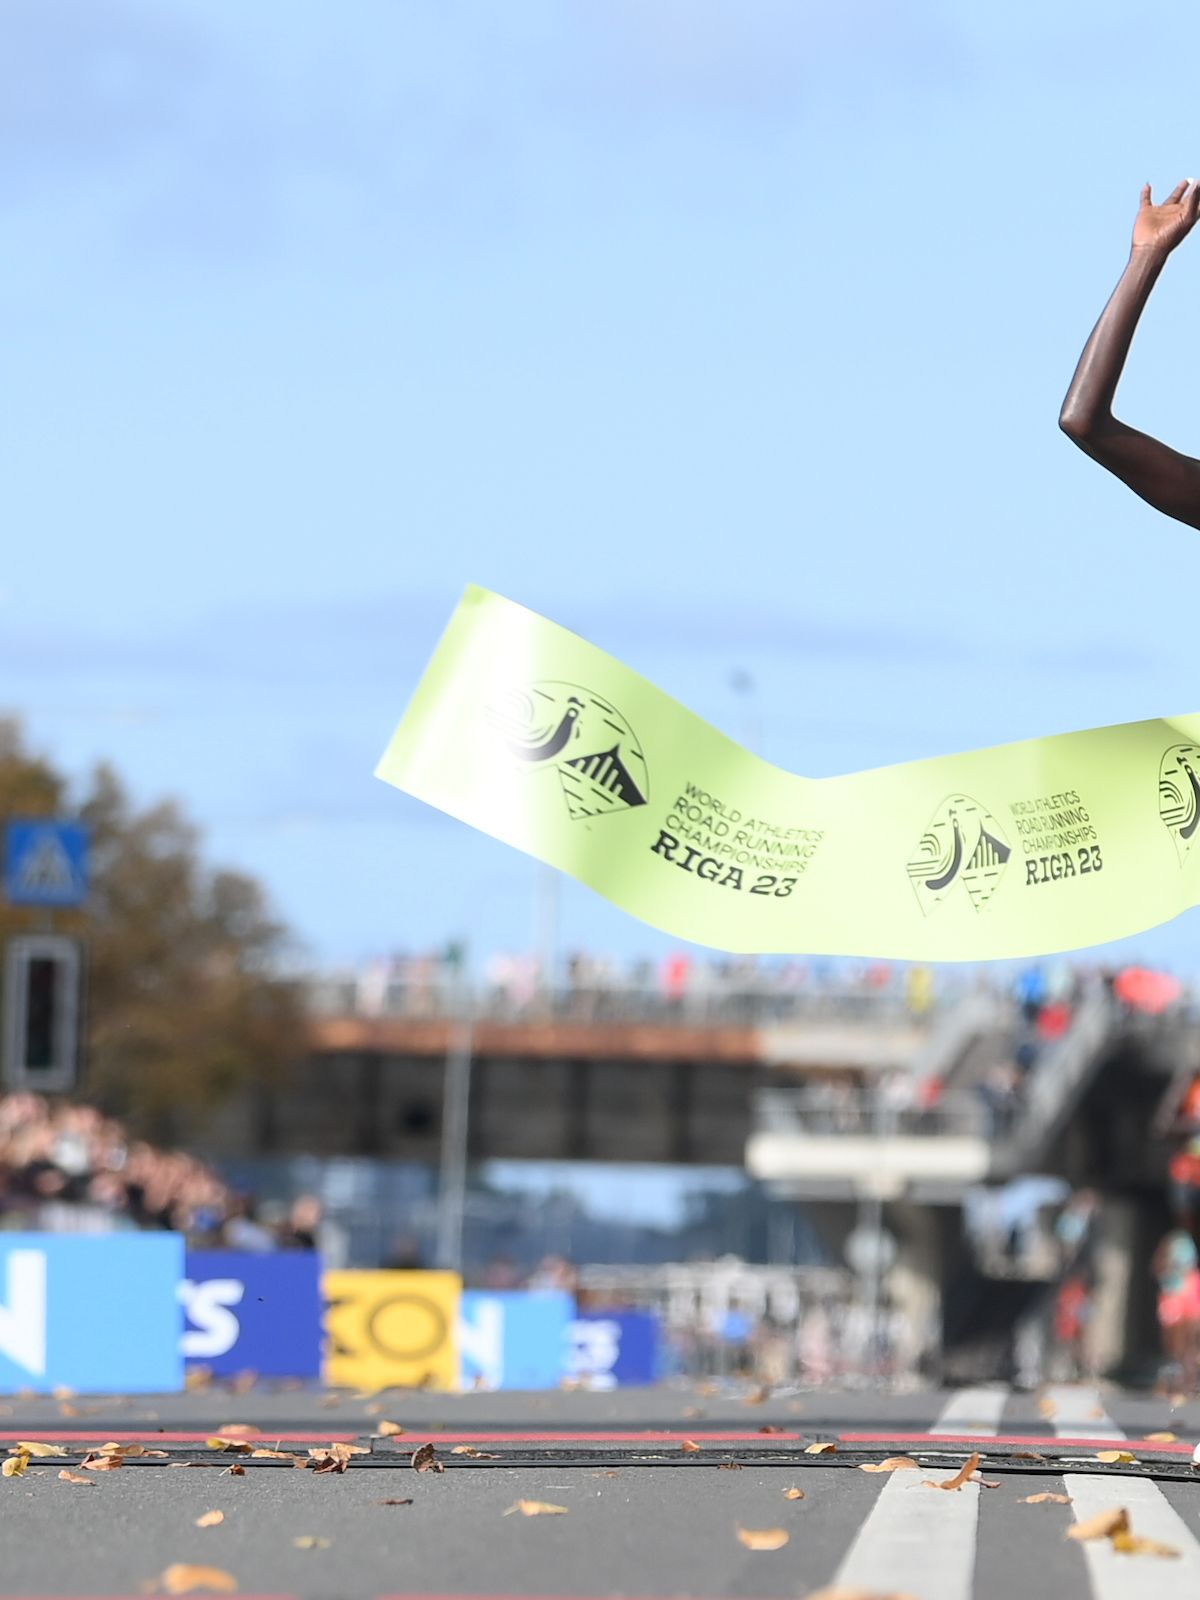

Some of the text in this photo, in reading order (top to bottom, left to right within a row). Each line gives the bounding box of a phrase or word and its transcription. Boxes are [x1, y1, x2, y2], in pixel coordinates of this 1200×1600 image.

[673, 796, 817, 858] ROAD RUNNING
[685, 781, 825, 842] WORLD ATHLETICS
[1022, 825, 1098, 854] CHAMPIONSHIPS
[1040, 806, 1090, 832] RUNNING
[650, 829, 798, 897] RIGA 23
[665, 813, 808, 874] CHAMPIONSHIPS
[1025, 845, 1103, 886] RIGA 23
